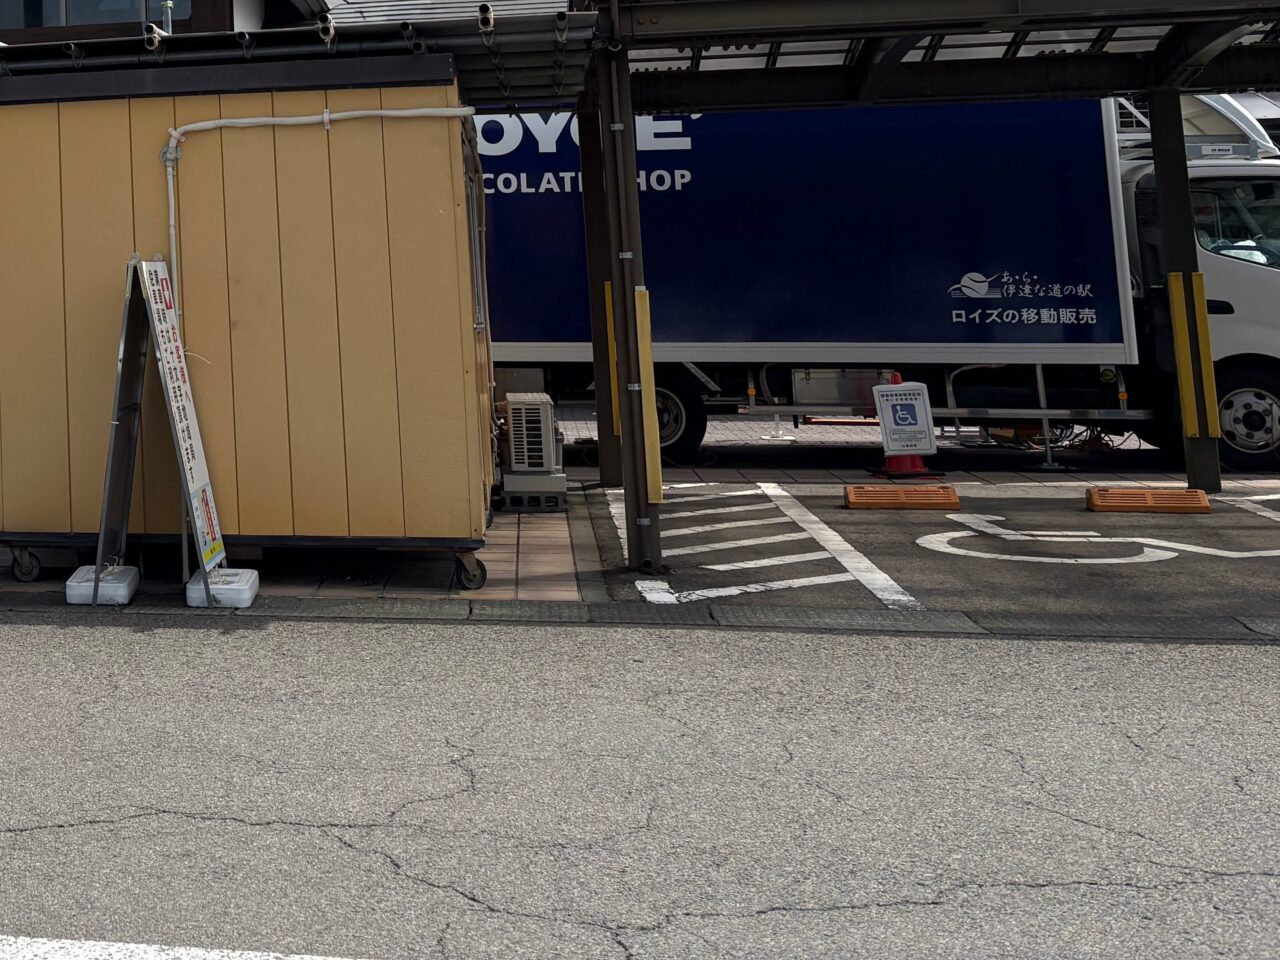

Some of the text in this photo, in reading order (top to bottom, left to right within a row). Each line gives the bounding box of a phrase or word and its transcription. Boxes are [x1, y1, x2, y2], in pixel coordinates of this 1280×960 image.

[482, 171, 582, 195] COLAT
[1002, 283, 1094, 298] 伊達な道の駅
[951, 307, 1097, 325] ロイズの移動販売
